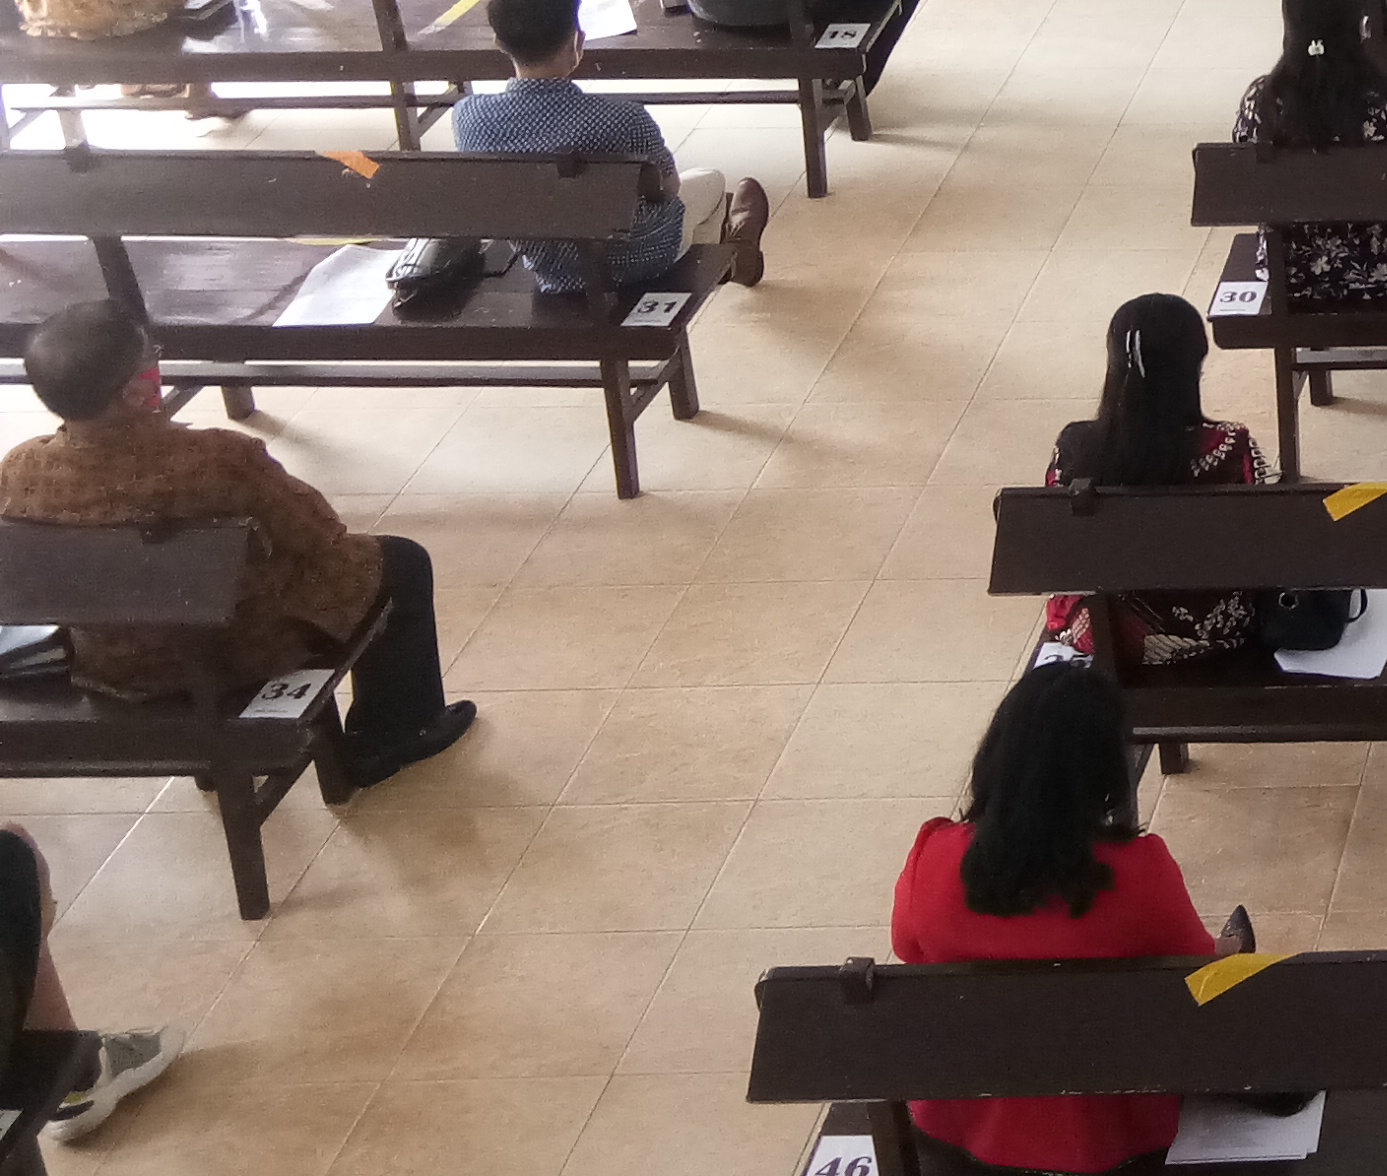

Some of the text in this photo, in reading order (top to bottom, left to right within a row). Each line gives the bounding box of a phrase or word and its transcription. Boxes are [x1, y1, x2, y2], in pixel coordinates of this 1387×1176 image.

[1219, 290, 1258, 304] 30
[638, 299, 679, 315] 31
[261, 683, 312, 701] 34
[813, 1157, 873, 1176] 46
